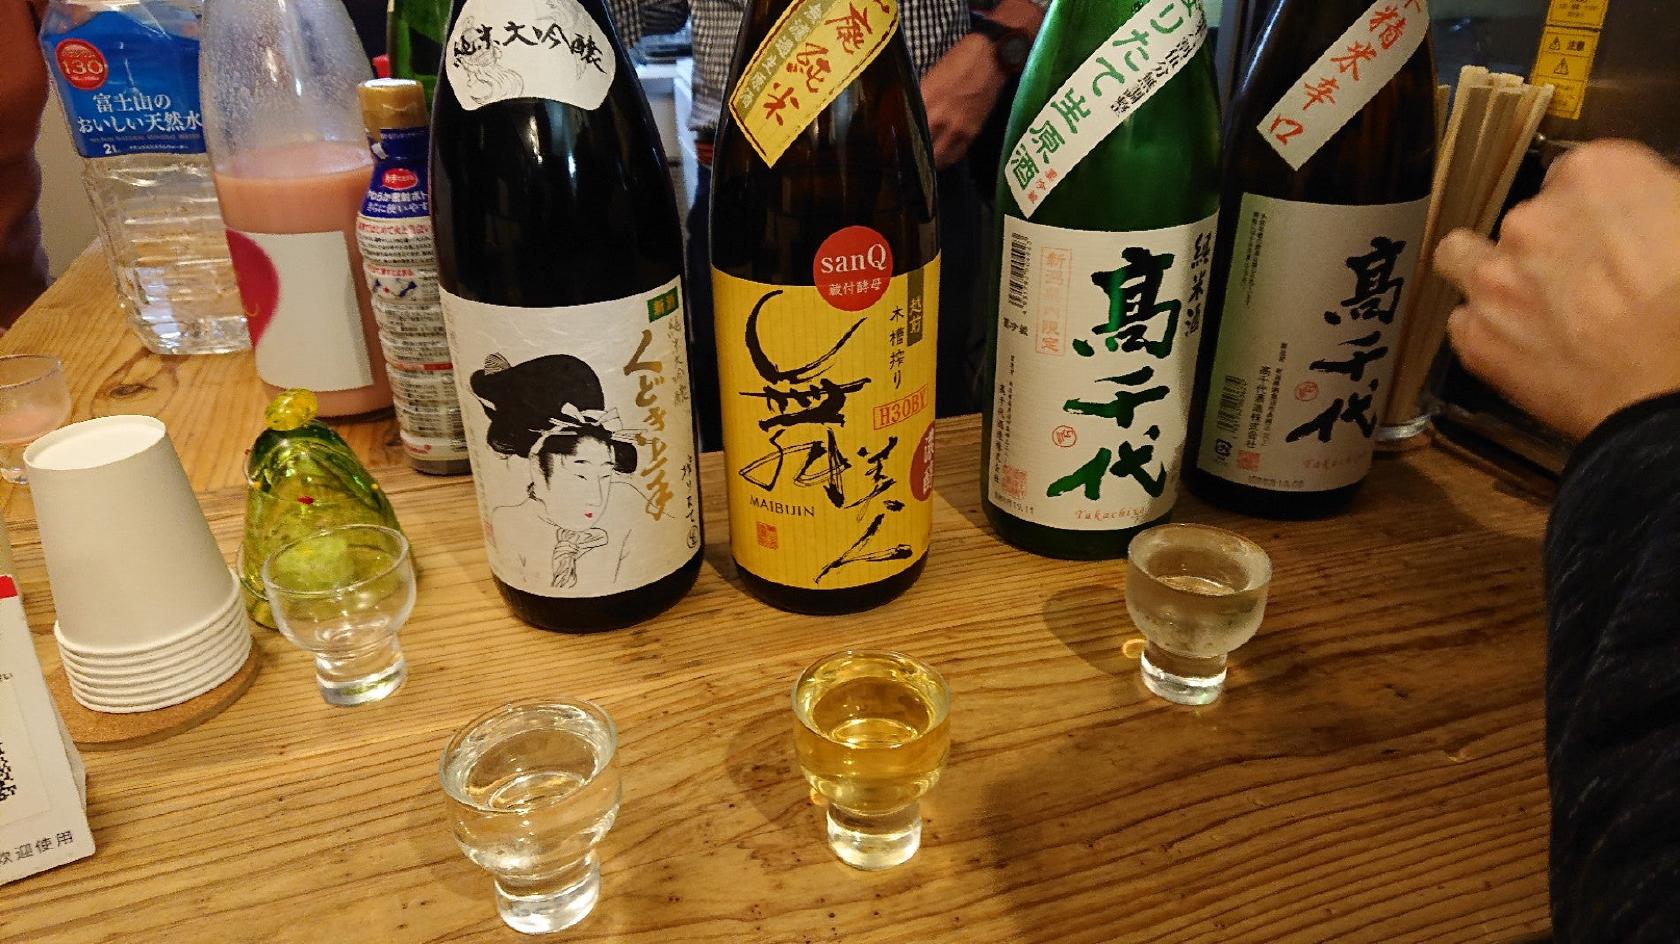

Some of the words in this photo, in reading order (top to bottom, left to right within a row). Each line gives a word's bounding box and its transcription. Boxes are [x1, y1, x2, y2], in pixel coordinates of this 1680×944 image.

[63, 59, 104, 76] 130
[1268, 0, 1421, 145] 精米辛口
[93, 92, 172, 113] 富士山の
[77, 110, 203, 134] おいしい天然水
[102, 143, 118, 154] 2L
[821, 243, 887, 273] sanQ
[829, 277, 882, 297] 蔵付酵母
[1185, 232, 1212, 337] 純米酒
[889, 305, 905, 390] 木槽搾り
[880, 389, 928, 426] H30BY
[750, 494, 815, 517] MAIBIJIN
